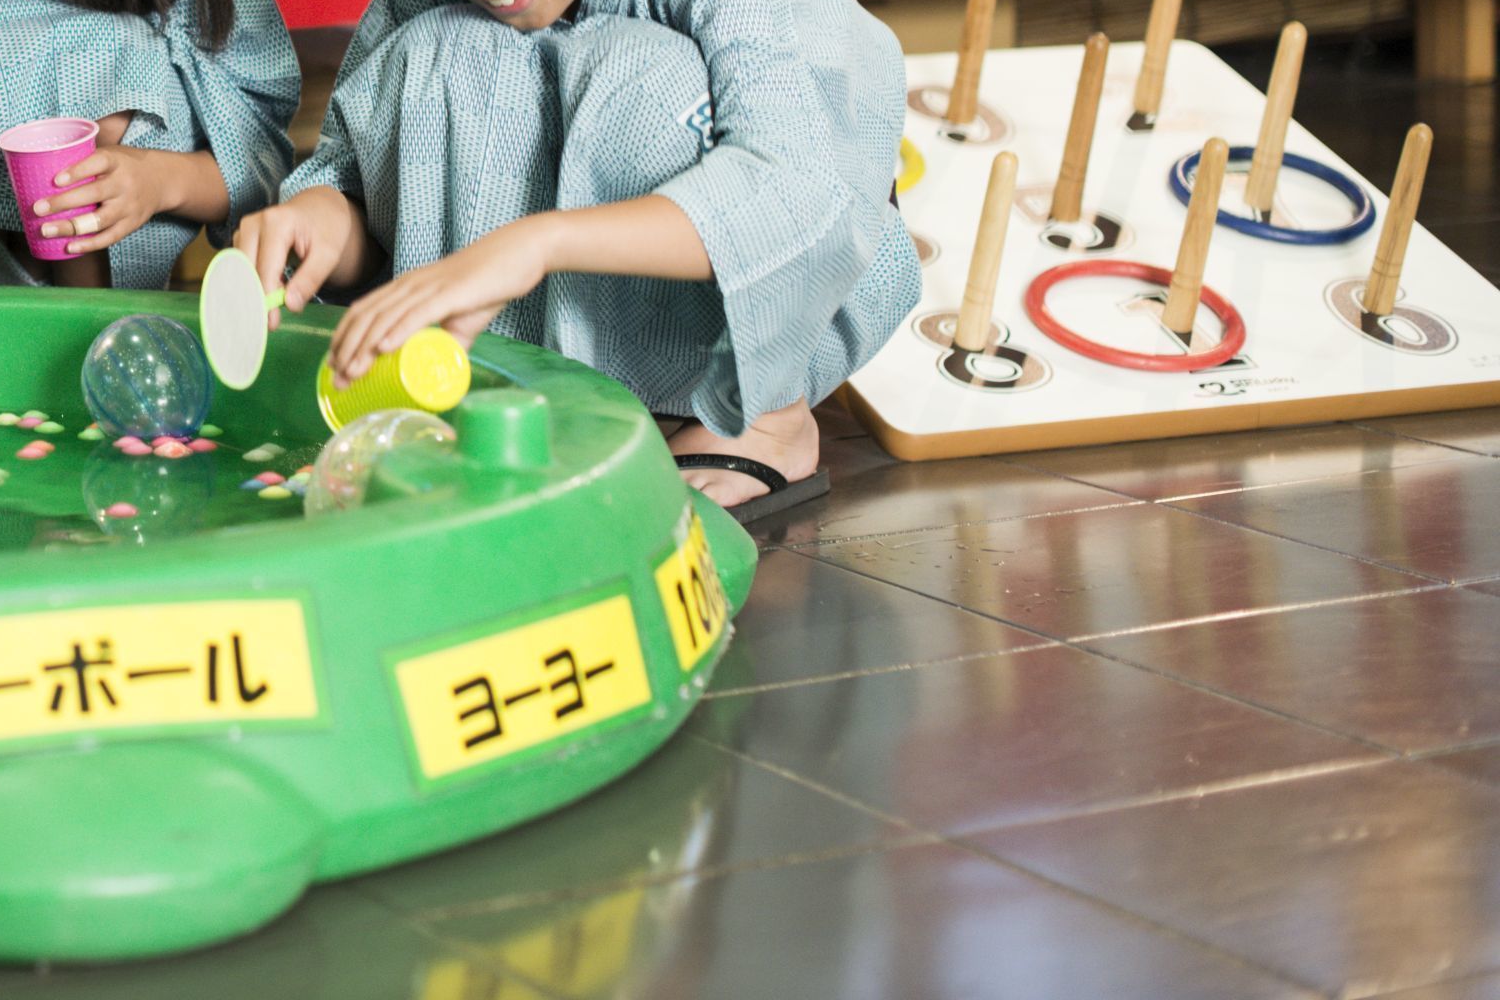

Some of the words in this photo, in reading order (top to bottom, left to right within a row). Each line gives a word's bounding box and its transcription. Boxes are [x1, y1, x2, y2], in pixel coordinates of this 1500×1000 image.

[910, 309, 1054, 393] 8
[452, 648, 615, 750] ヨーヨー
